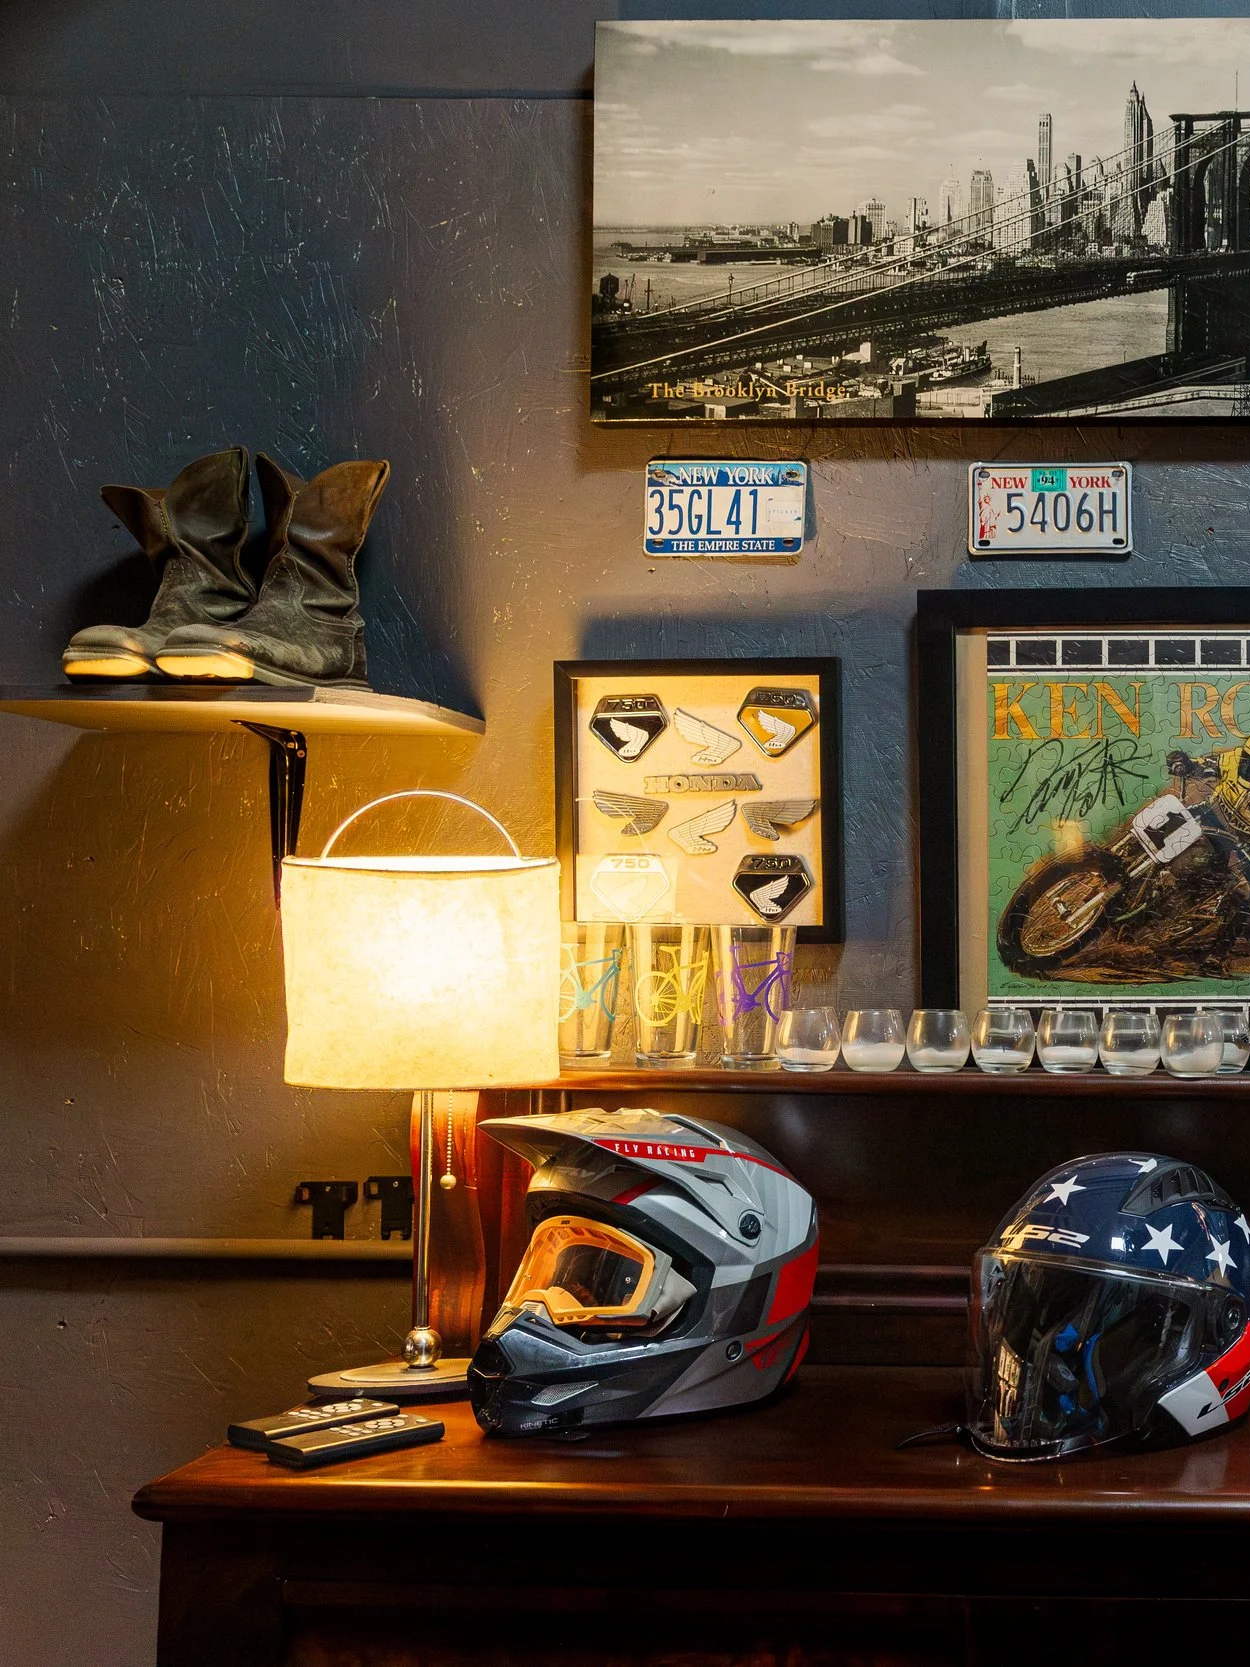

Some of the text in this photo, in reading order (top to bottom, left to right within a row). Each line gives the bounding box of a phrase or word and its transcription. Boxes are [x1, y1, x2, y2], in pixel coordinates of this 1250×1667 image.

[650, 383, 684, 398] The
[692, 382, 777, 401] Brooklyn
[679, 466, 773, 485] NEW YORK
[991, 476, 1112, 489] NEW YORK
[1006, 491, 1118, 533] 5406H
[672, 540, 776, 551] THE EMPIRE STATE
[989, 682, 1143, 740] KEN
[644, 773, 762, 794] HONDA
[610, 858, 650, 869] 750
[615, 1143, 696, 1158] FLY RACING
